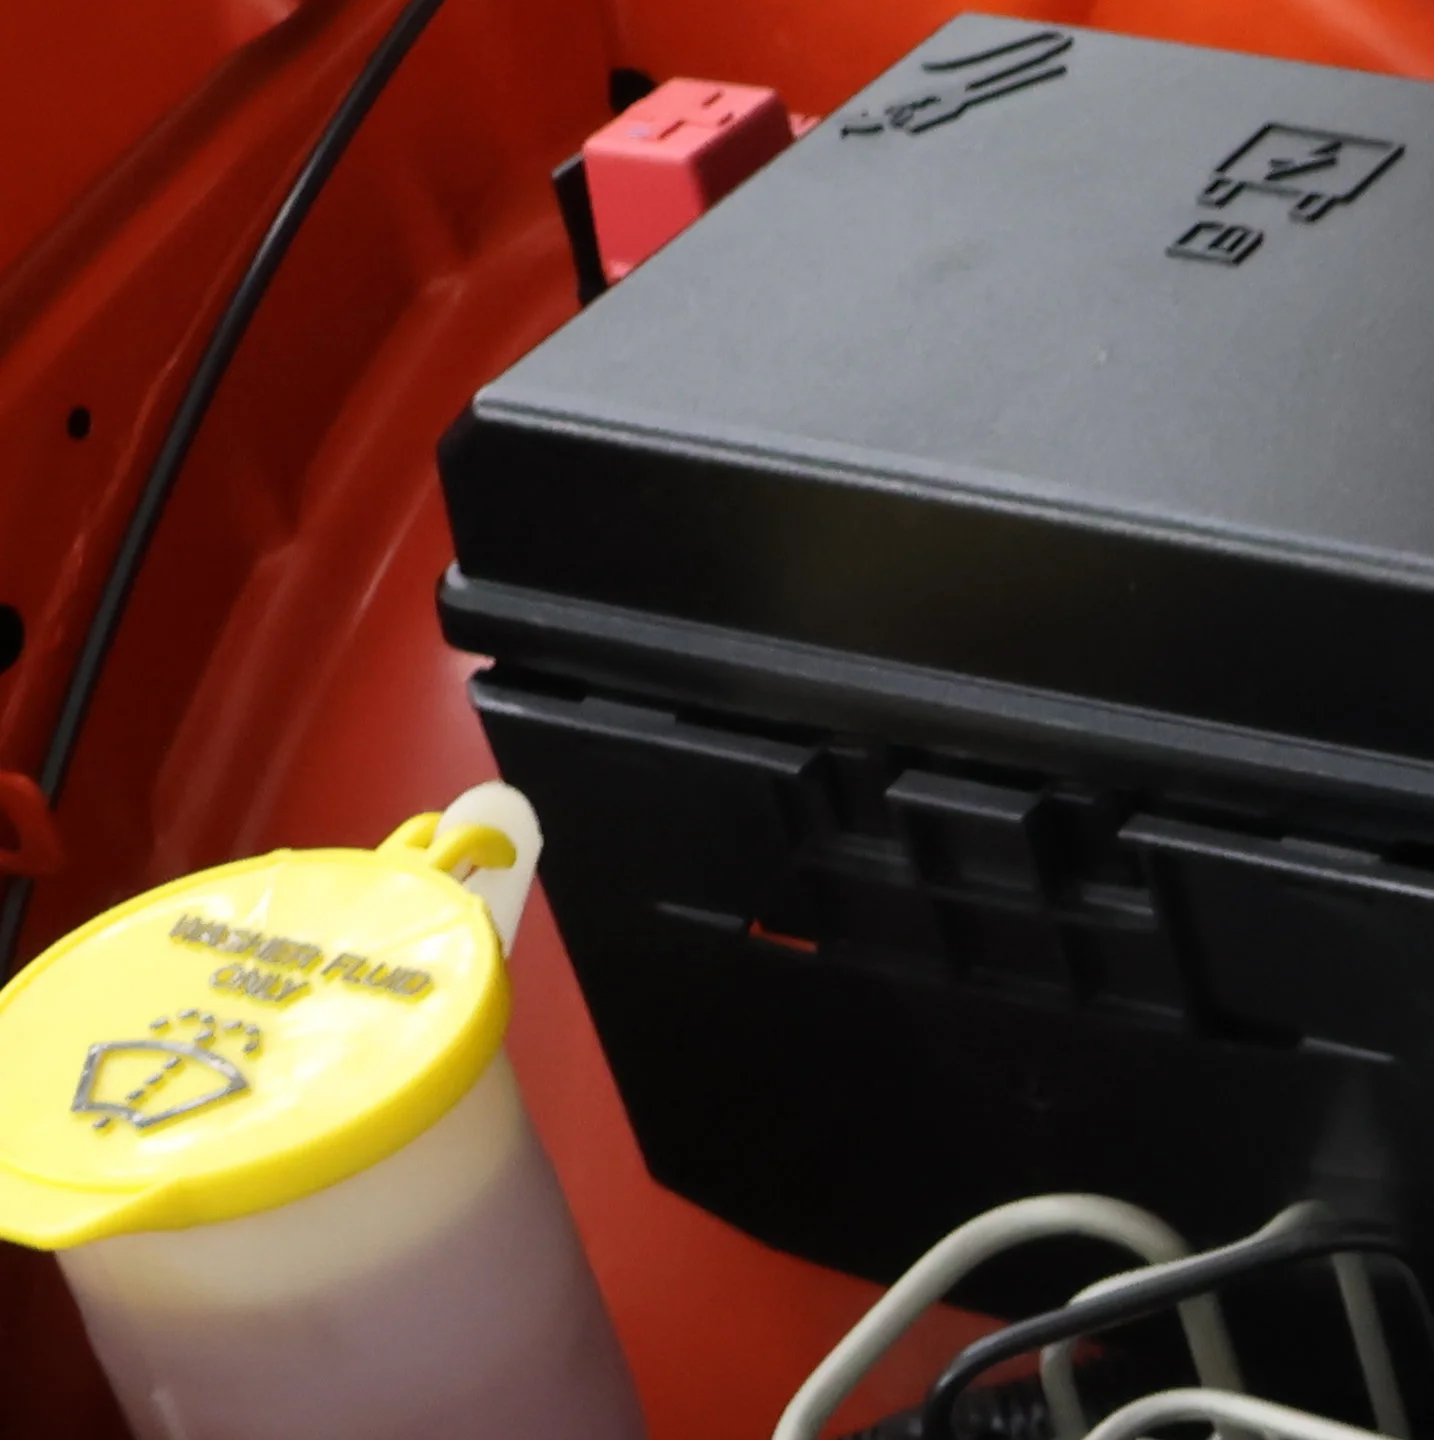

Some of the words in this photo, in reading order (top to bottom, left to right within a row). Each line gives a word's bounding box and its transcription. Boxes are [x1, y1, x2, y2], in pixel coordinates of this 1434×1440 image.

[169, 913, 324, 969] WASHER
[320, 951, 434, 998] FLUID
[210, 963, 310, 1003] ONLY
